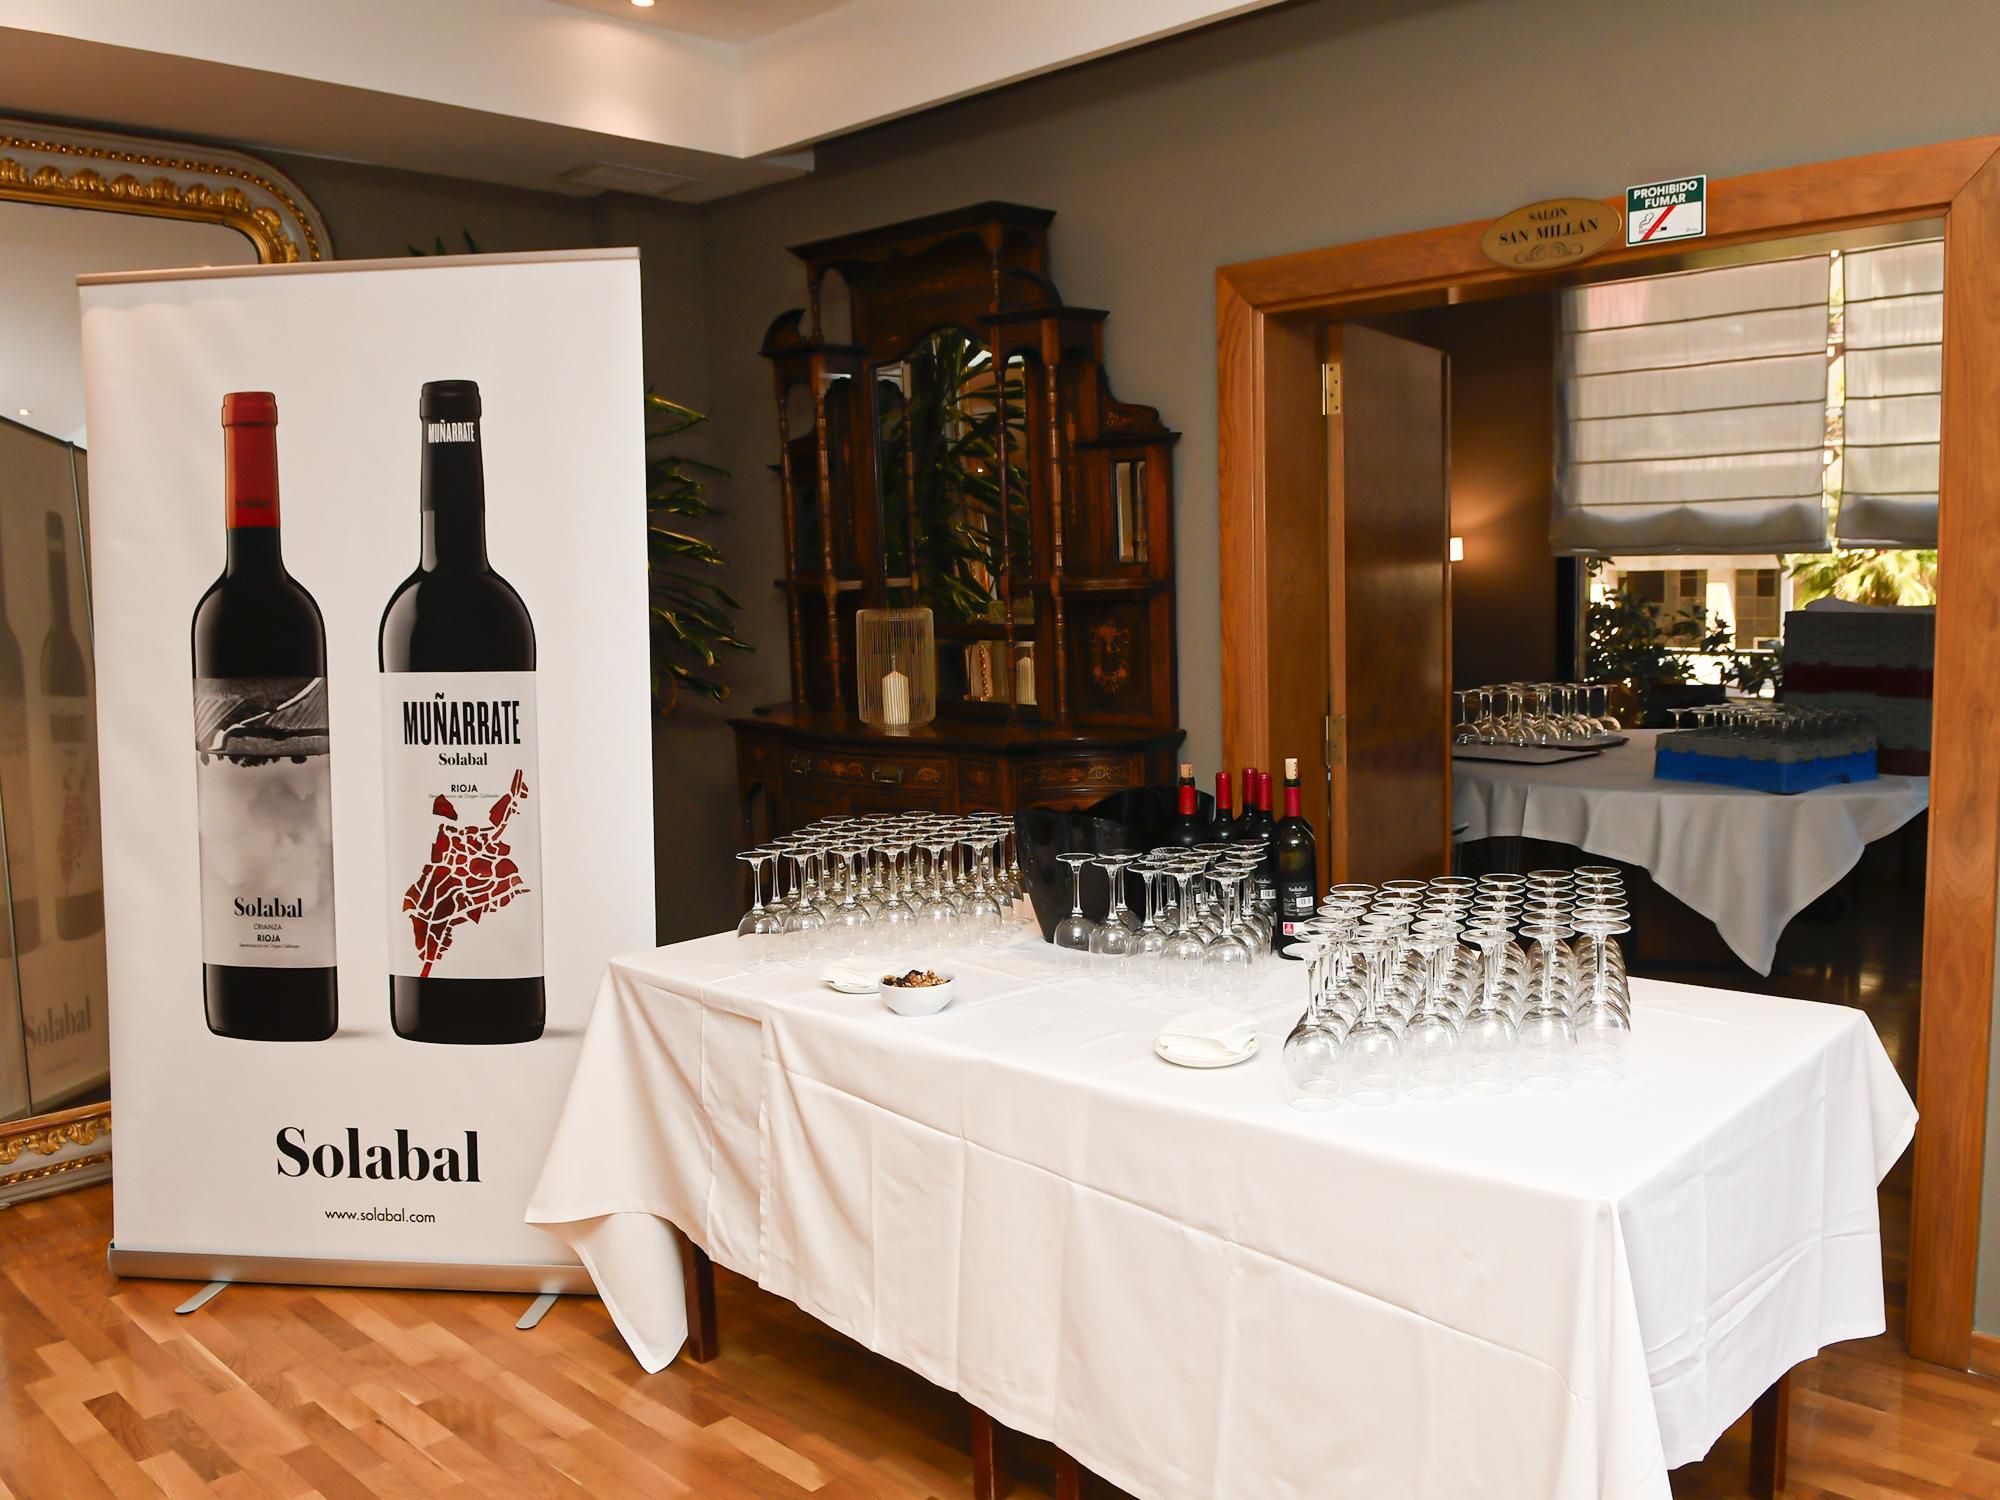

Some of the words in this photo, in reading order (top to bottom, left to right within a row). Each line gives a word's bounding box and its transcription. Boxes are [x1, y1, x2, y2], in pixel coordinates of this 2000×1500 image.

[1633, 180, 1698, 200] PROHIBIDO
[1645, 193, 1686, 208] FUMAR
[1499, 229, 1529, 245] SAN
[428, 419, 475, 443] MUÑARRATE
[403, 692, 521, 745] MUÑARRATE
[438, 752, 488, 766] Solabal
[450, 784, 478, 792] RIOJA
[233, 897, 303, 918] Solabal
[253, 923, 283, 931] CRIANZA
[257, 934, 281, 942] RIOJA
[276, 1126, 483, 1183] Solabal
[324, 1207, 436, 1223] www.solabal.com
